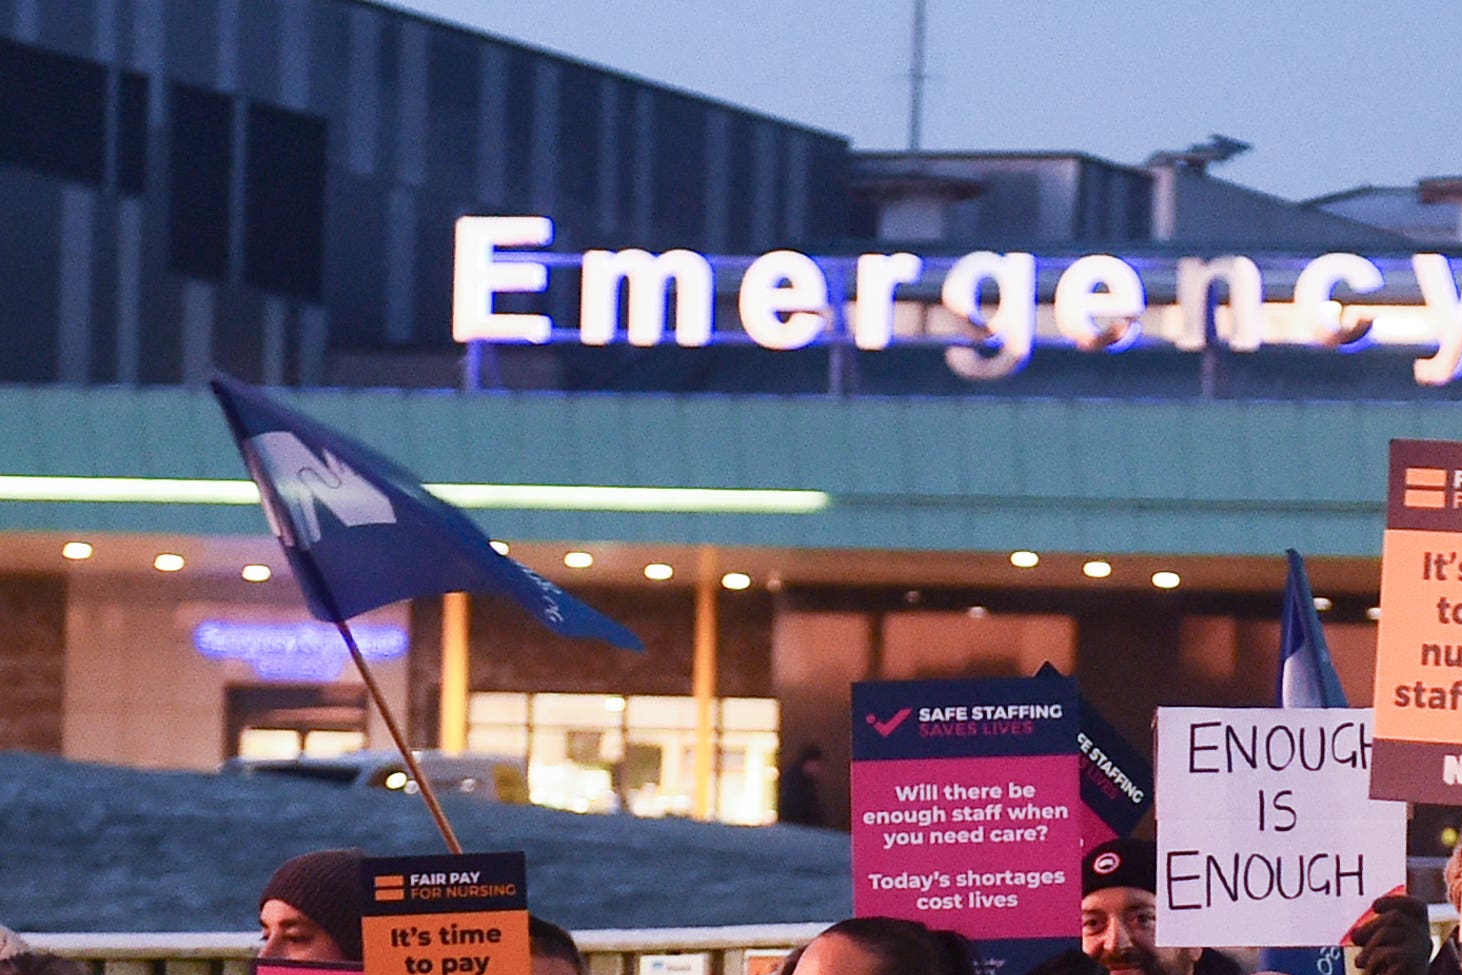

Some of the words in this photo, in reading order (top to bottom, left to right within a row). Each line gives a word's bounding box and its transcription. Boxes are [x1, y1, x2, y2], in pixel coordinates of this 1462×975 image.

[919, 706, 968, 722] SAFE
[971, 704, 1063, 720] STAFFING
[919, 723, 977, 738] SAVES
[983, 721, 1033, 735] LIVES
[1189, 721, 1373, 774] ENOUGH
[1089, 747, 1144, 804] STAFFING
[895, 784, 938, 801] Will
[944, 784, 1003, 800] there
[1008, 782, 1036, 799] be
[862, 805, 946, 828] enough
[951, 805, 1002, 822] staff
[1008, 804, 1069, 820] when
[1258, 789, 1297, 832] IS
[883, 831, 924, 850] you
[929, 827, 984, 844] need
[990, 825, 1049, 844] care?
[410, 874, 447, 886] FAIR
[449, 871, 480, 884] PAY
[868, 872, 951, 894] Today's
[955, 869, 1066, 893] shortages
[1166, 850, 1364, 910] ENOUGH
[411, 887, 442, 899] FOR
[446, 884, 516, 898] NURSING
[916, 895, 963, 911] cost
[968, 892, 1019, 908] lives
[390, 926, 431, 948] It's
[439, 923, 502, 945] time
[404, 957, 433, 975] to
